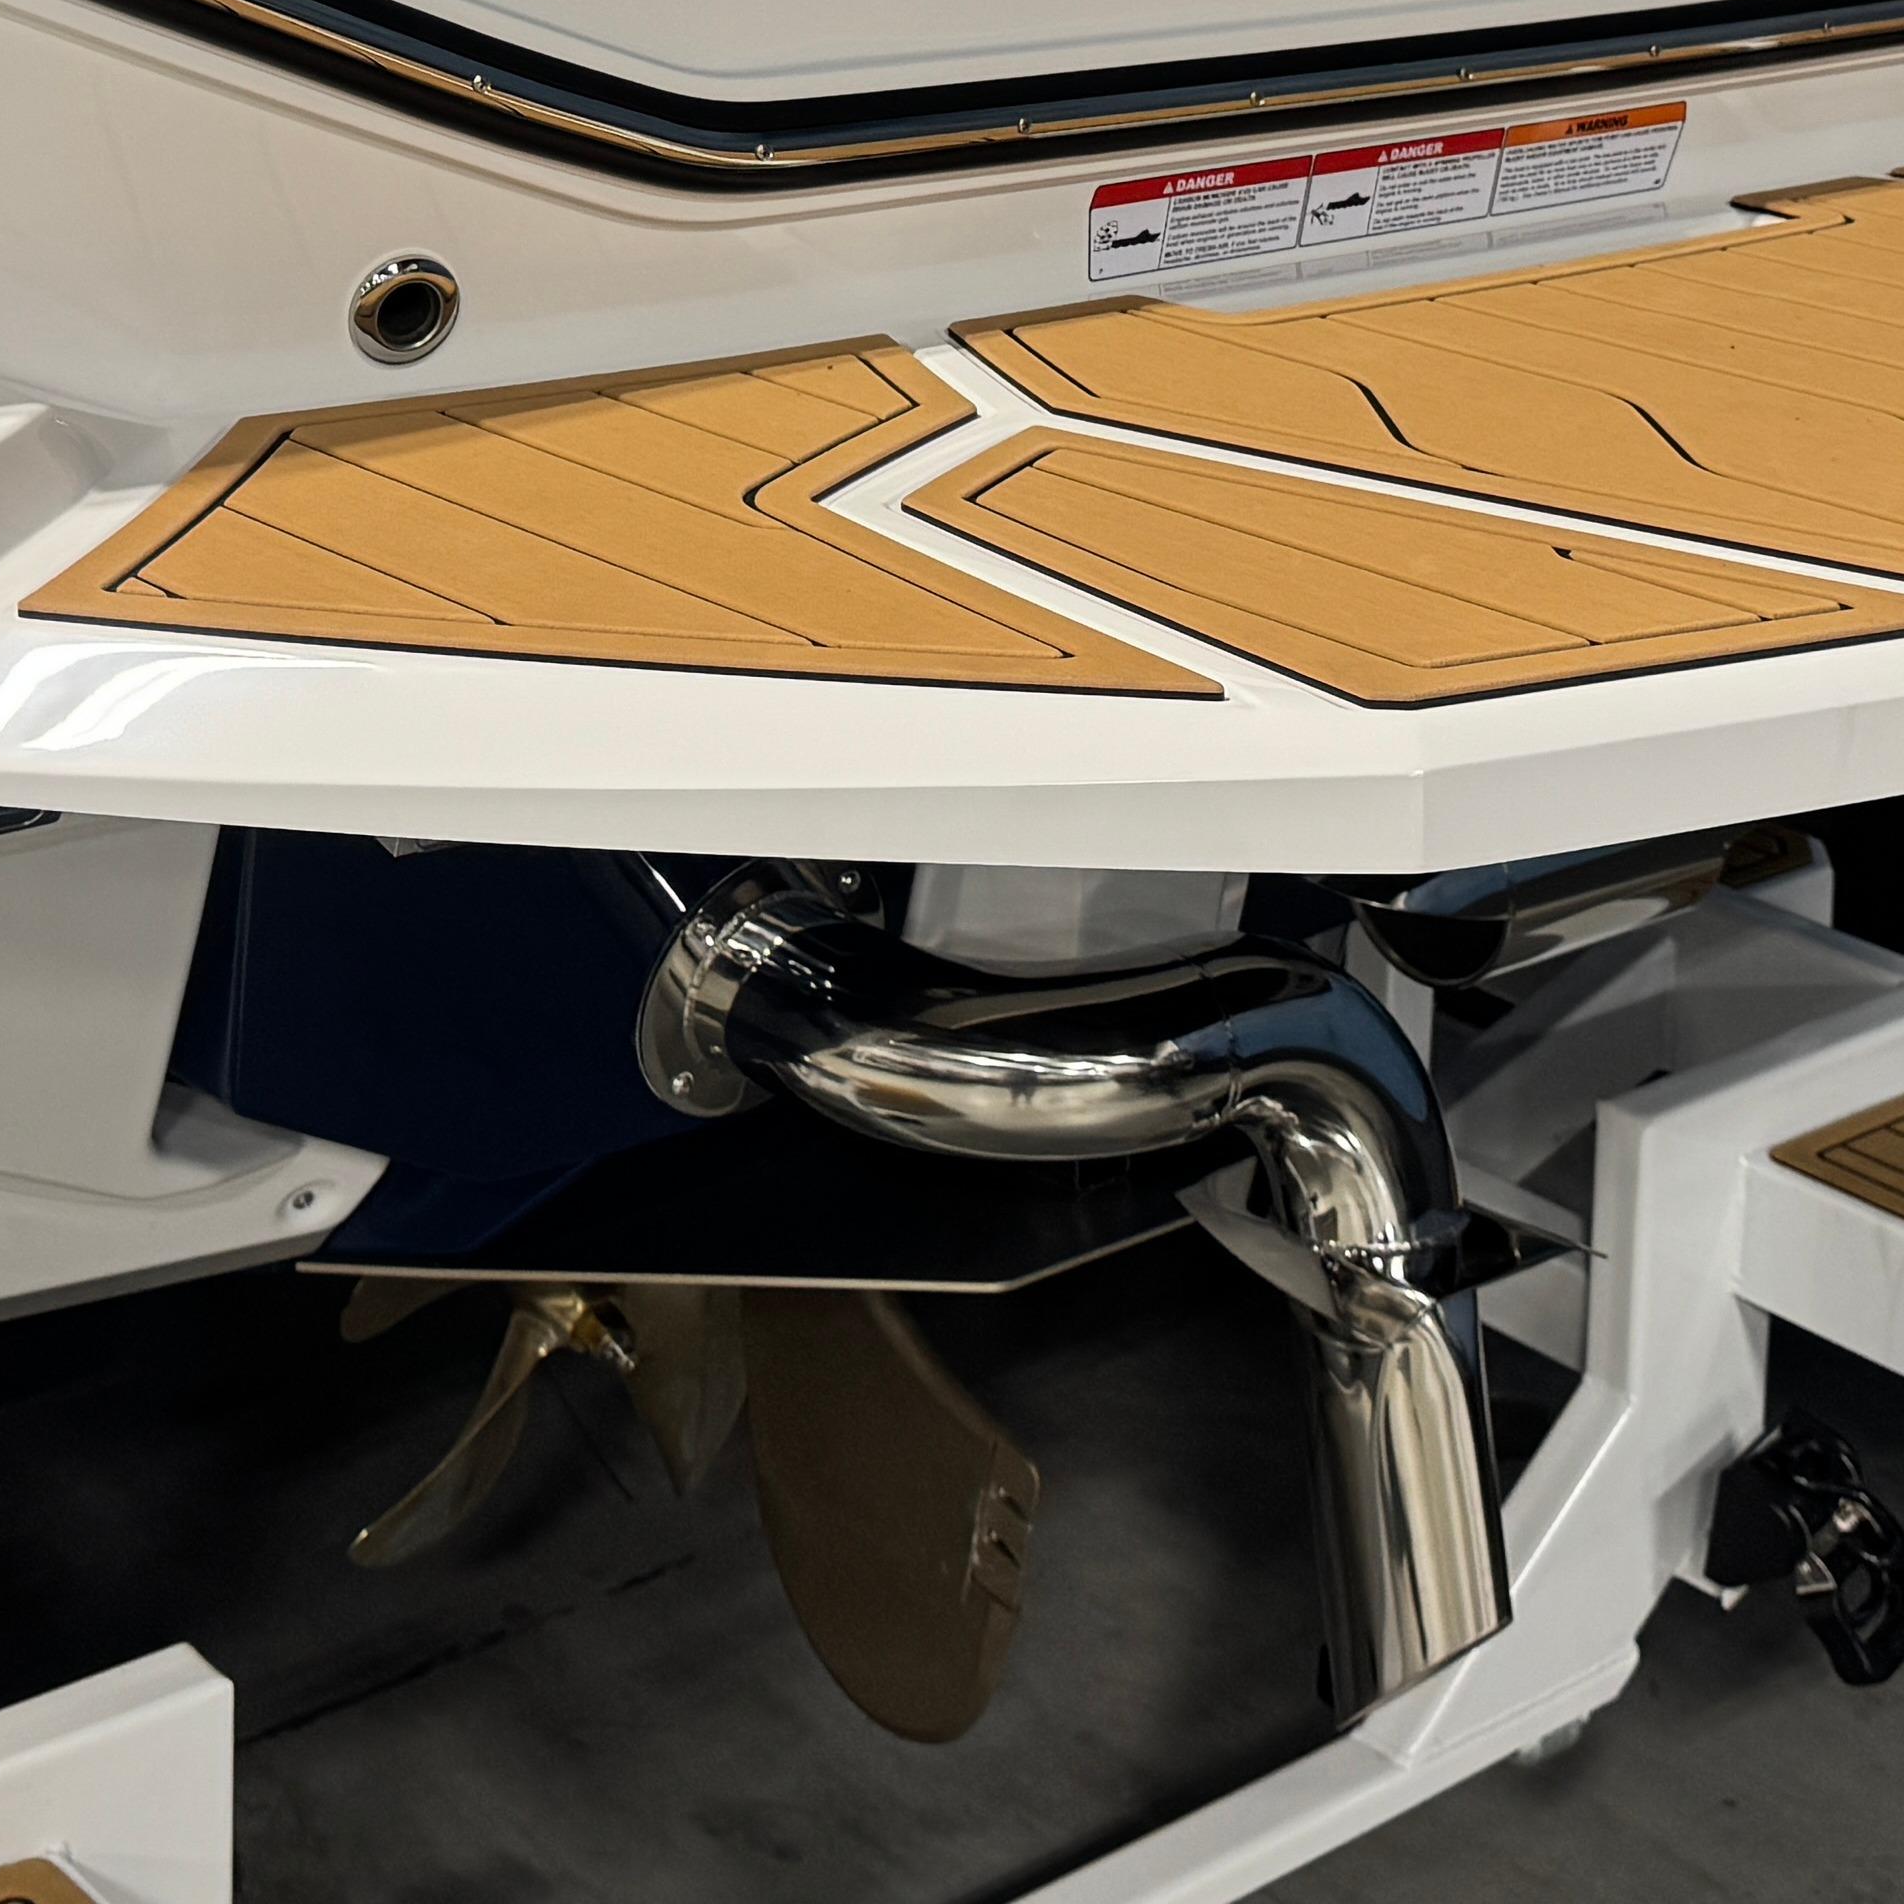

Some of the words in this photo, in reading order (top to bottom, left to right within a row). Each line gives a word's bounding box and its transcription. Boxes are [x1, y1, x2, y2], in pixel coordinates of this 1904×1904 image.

[1576, 115, 1630, 133] WARNING
[1390, 141, 1445, 161] DANGER
[1175, 171, 1235, 193] DANGER
